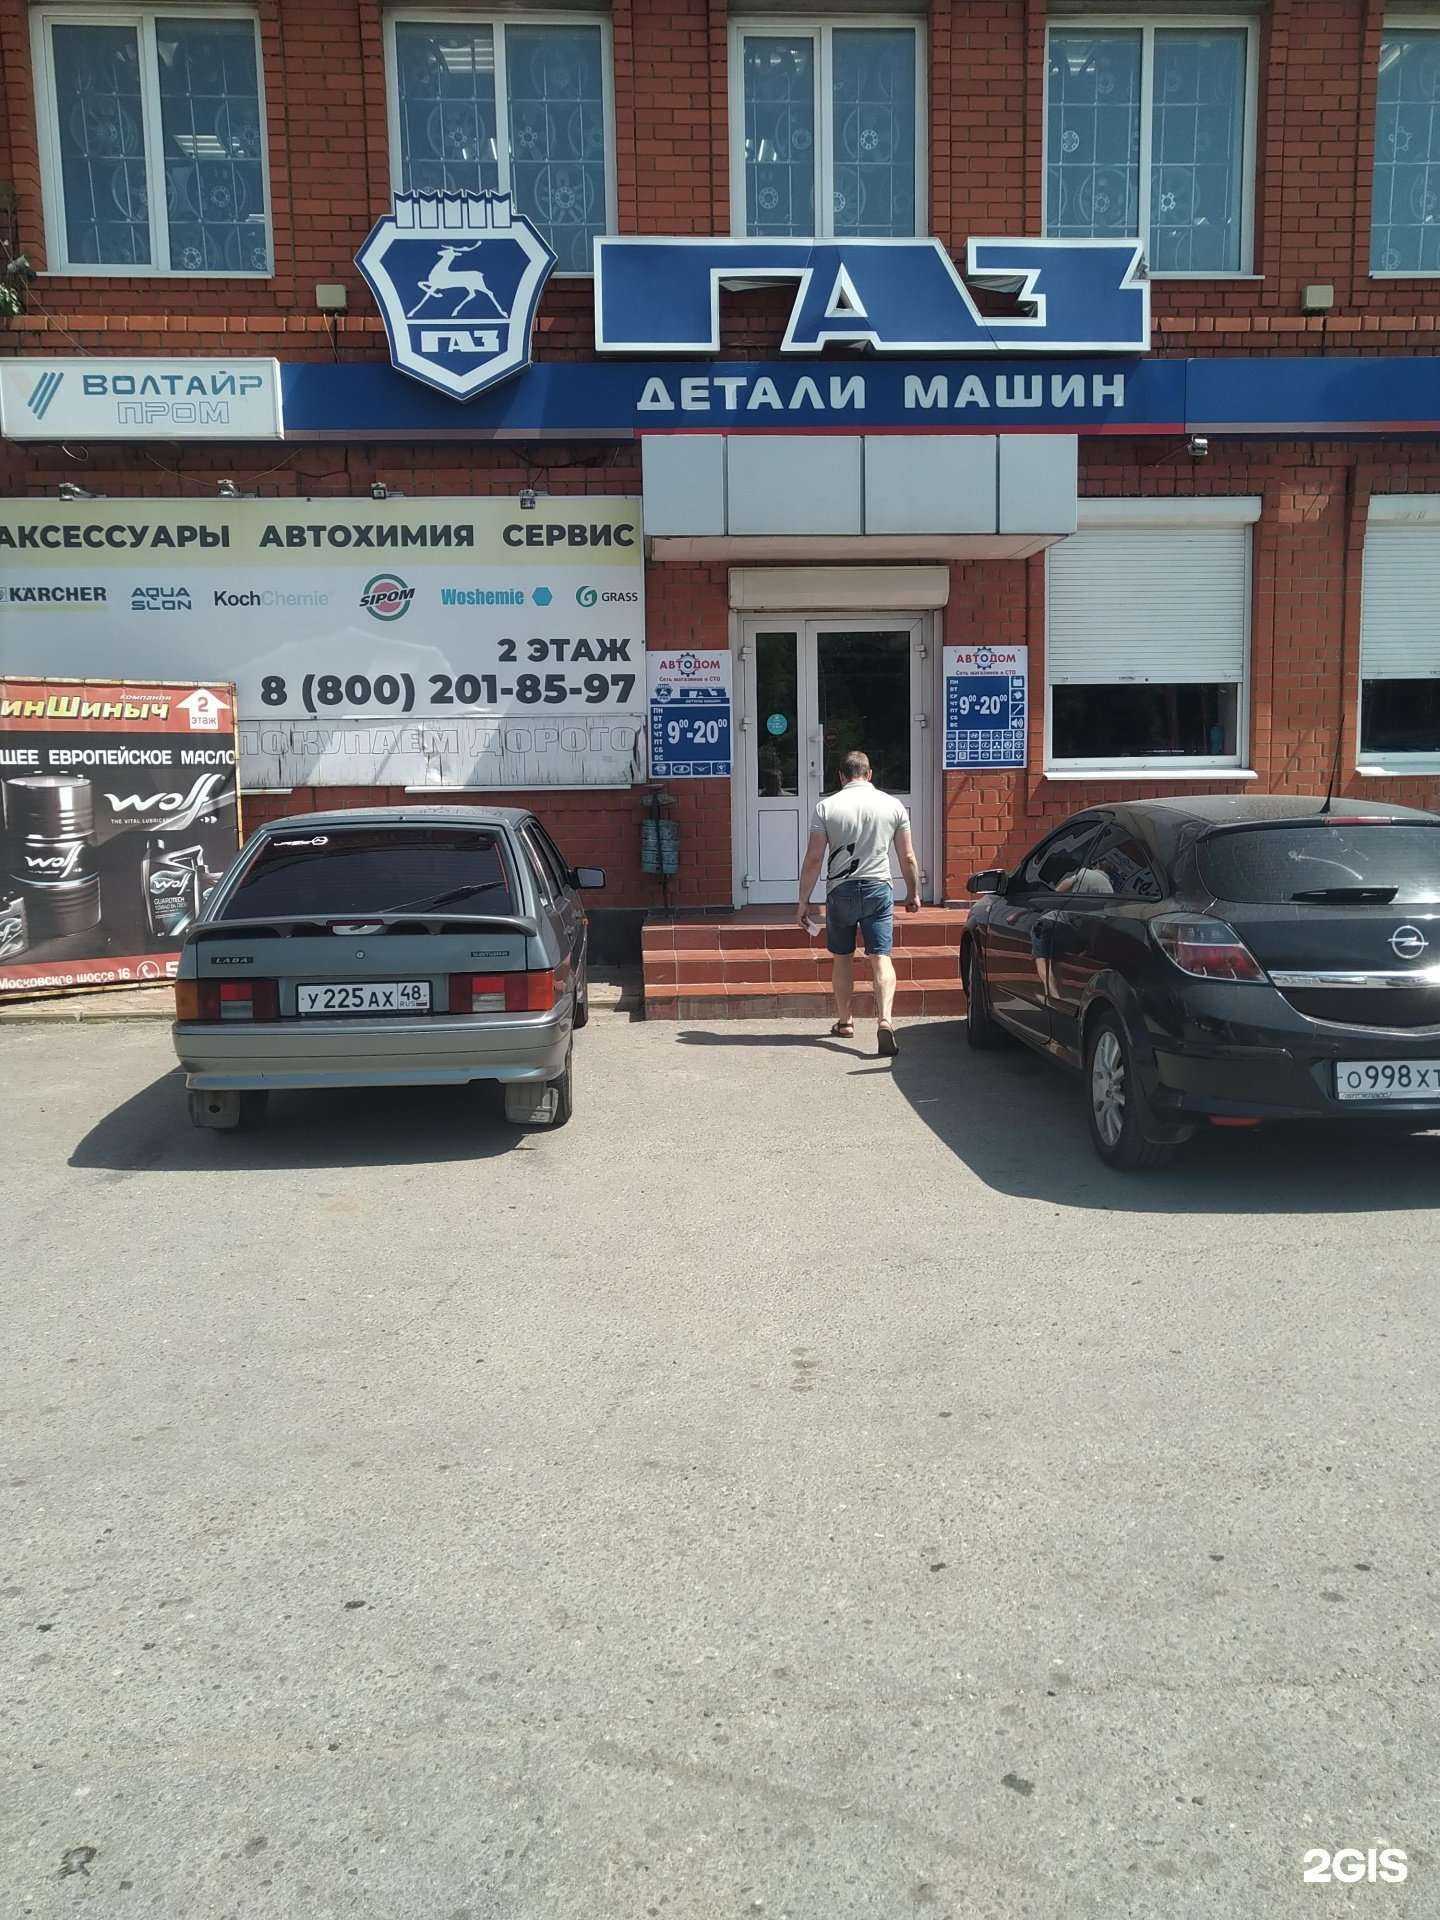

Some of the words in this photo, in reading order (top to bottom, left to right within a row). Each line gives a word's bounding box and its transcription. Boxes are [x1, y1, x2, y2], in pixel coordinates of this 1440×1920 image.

[593, 236, 1150, 352] ГАЗ
[421, 330, 499, 352] ГАЗ
[83, 370, 262, 395] ВОЛТАЙР
[636, 374, 866, 411] ДЕТАЛИ
[904, 372, 1125, 409] МАШИН
[117, 401, 229, 424] ПРОМ
[0, 524, 230, 549] АКСЕССУАРЫ
[259, 524, 474, 548] АВТОХИМИЯ
[502, 523, 635, 547] СЕРВИС
[9, 586, 107, 602] KÄRCHER
[131, 587, 191, 600] AQUA
[359, 587, 416, 607] SIPOM
[440, 588, 524, 606] Woshemie
[601, 592, 638, 602] GRASS
[497, 638, 517, 662] 2
[527, 638, 631, 662] ЭТАЖ
[956, 654, 1016, 663] АВТОДОМ
[660, 660, 720, 669] АВТОДОМ
[261, 675, 288, 706] 8
[302, 673, 415, 712] (800)
[428, 673, 636, 705] 201-85-97
[197, 696, 208, 712] 2
[240, 729, 459, 755] ПОКУПАЕМ
[470, 728, 639, 757] ДОРОГО
[49, 746, 172, 765] ЕВРОПЕЙСКОЕ
[181, 750, 235, 766] МАСЛО
[0, 974, 73, 990] Московское
[77, 970, 114, 984] шоссе
[118, 967, 131, 981] 16
[400, 984, 421, 1001] 48
